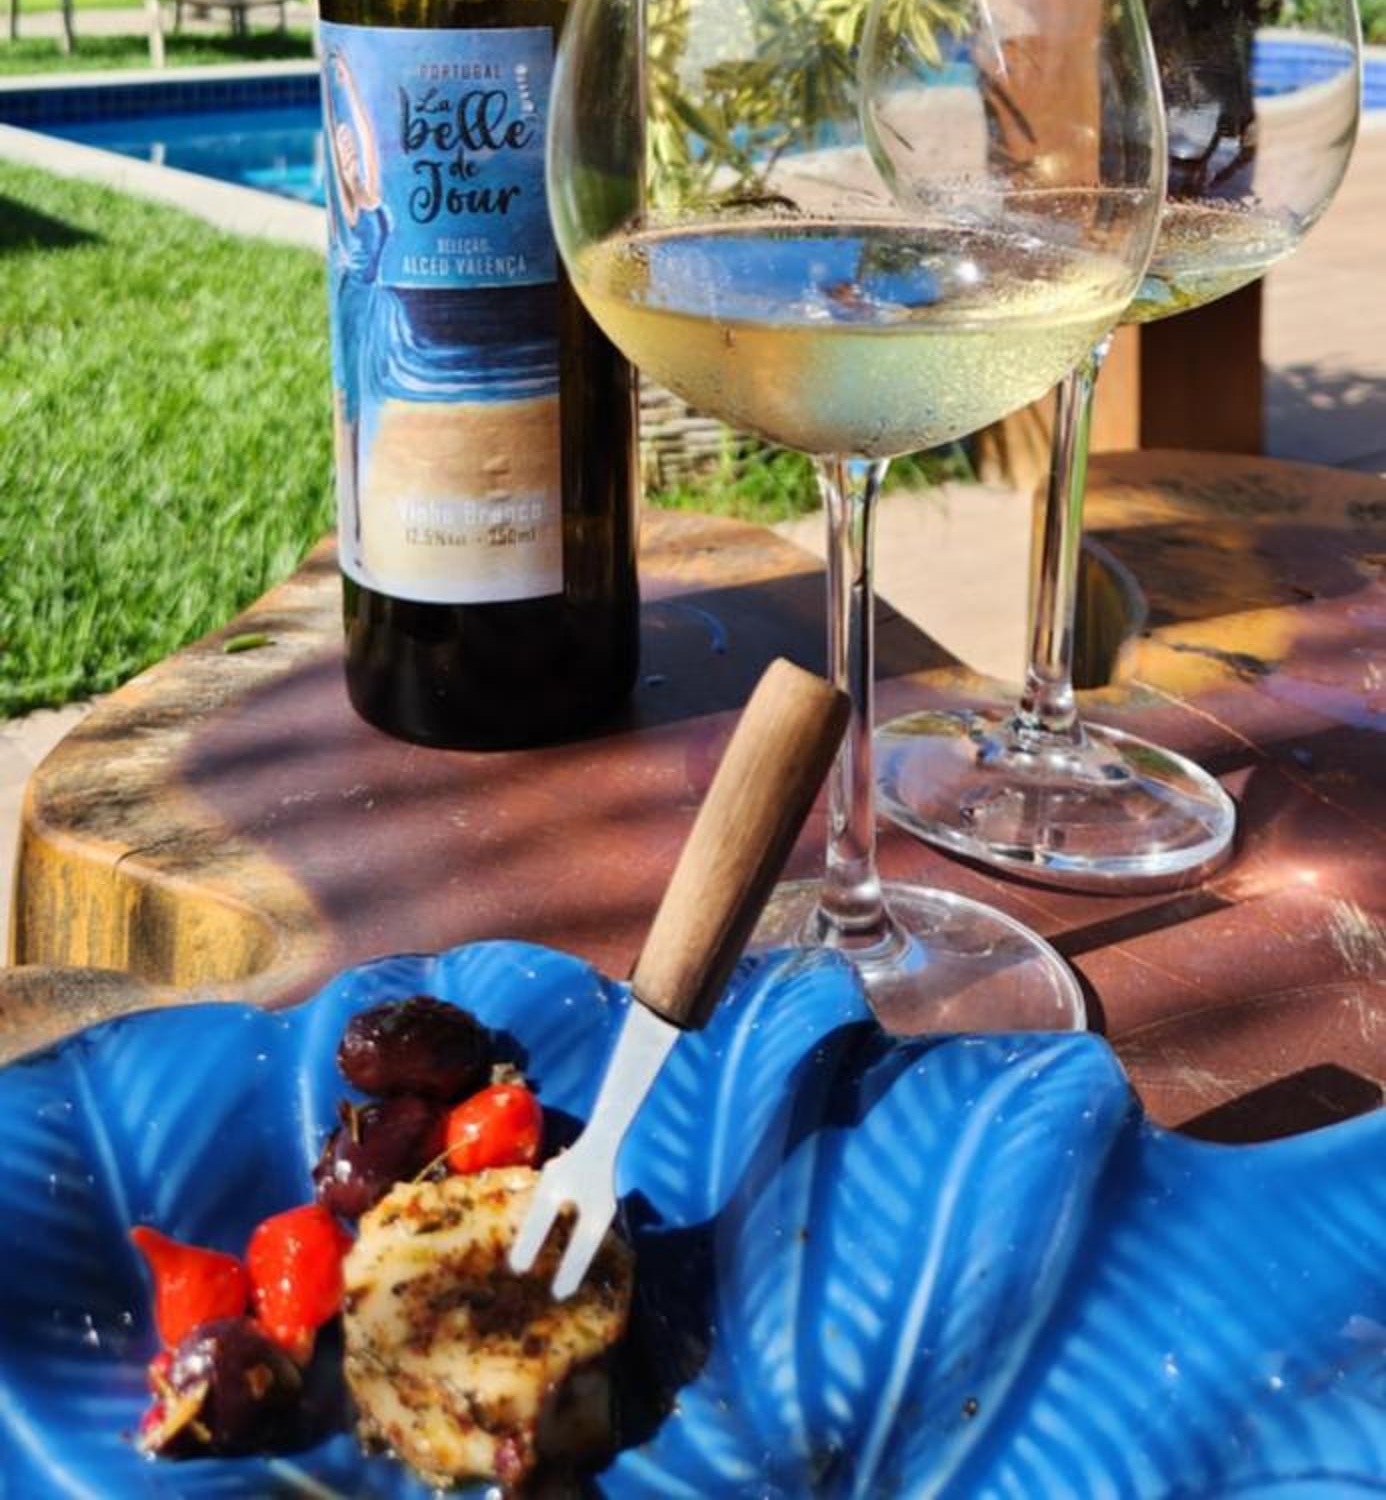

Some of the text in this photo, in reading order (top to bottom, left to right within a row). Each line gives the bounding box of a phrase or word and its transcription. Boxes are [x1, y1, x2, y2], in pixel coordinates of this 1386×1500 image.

[415, 86, 450, 114] La
[399, 86, 536, 154] belle
[448, 150, 481, 181] de
[409, 160, 521, 224] Jour
[403, 255, 527, 277] ALCEU VALENÇA
